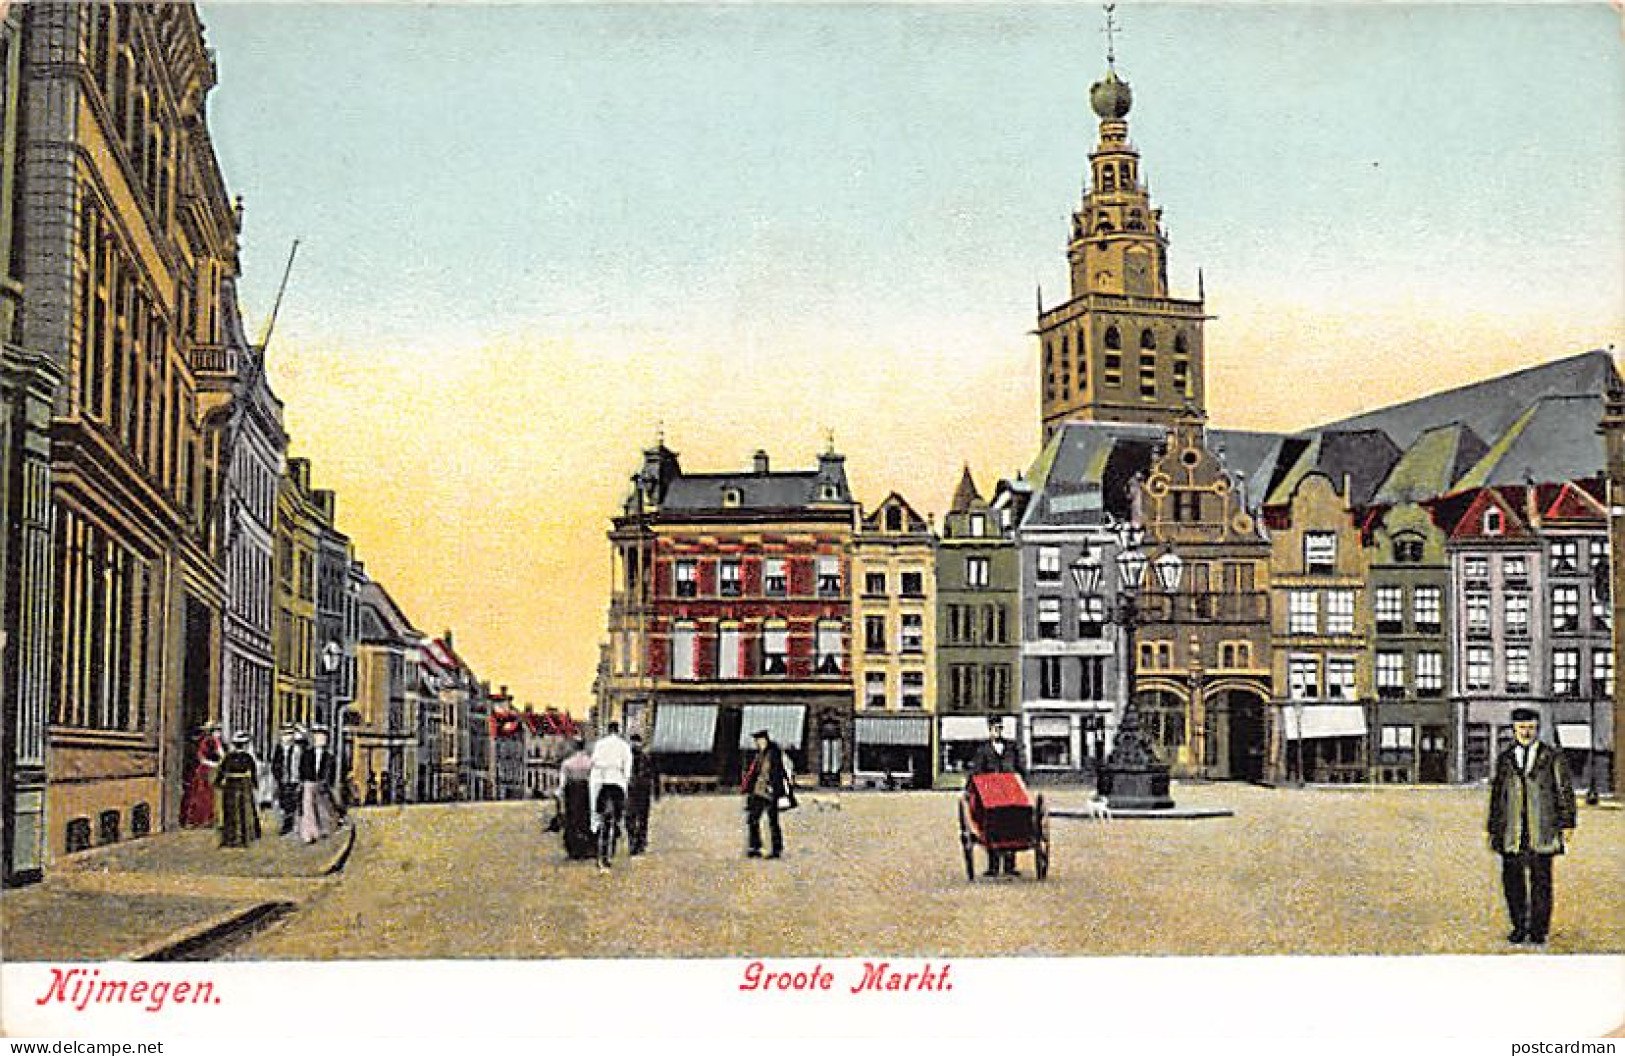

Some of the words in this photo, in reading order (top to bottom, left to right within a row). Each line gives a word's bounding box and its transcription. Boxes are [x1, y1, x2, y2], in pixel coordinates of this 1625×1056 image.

[35, 967, 221, 1012] Nijmegen.
[739, 961, 834, 991] Groote
[849, 962, 953, 993] Markt.
